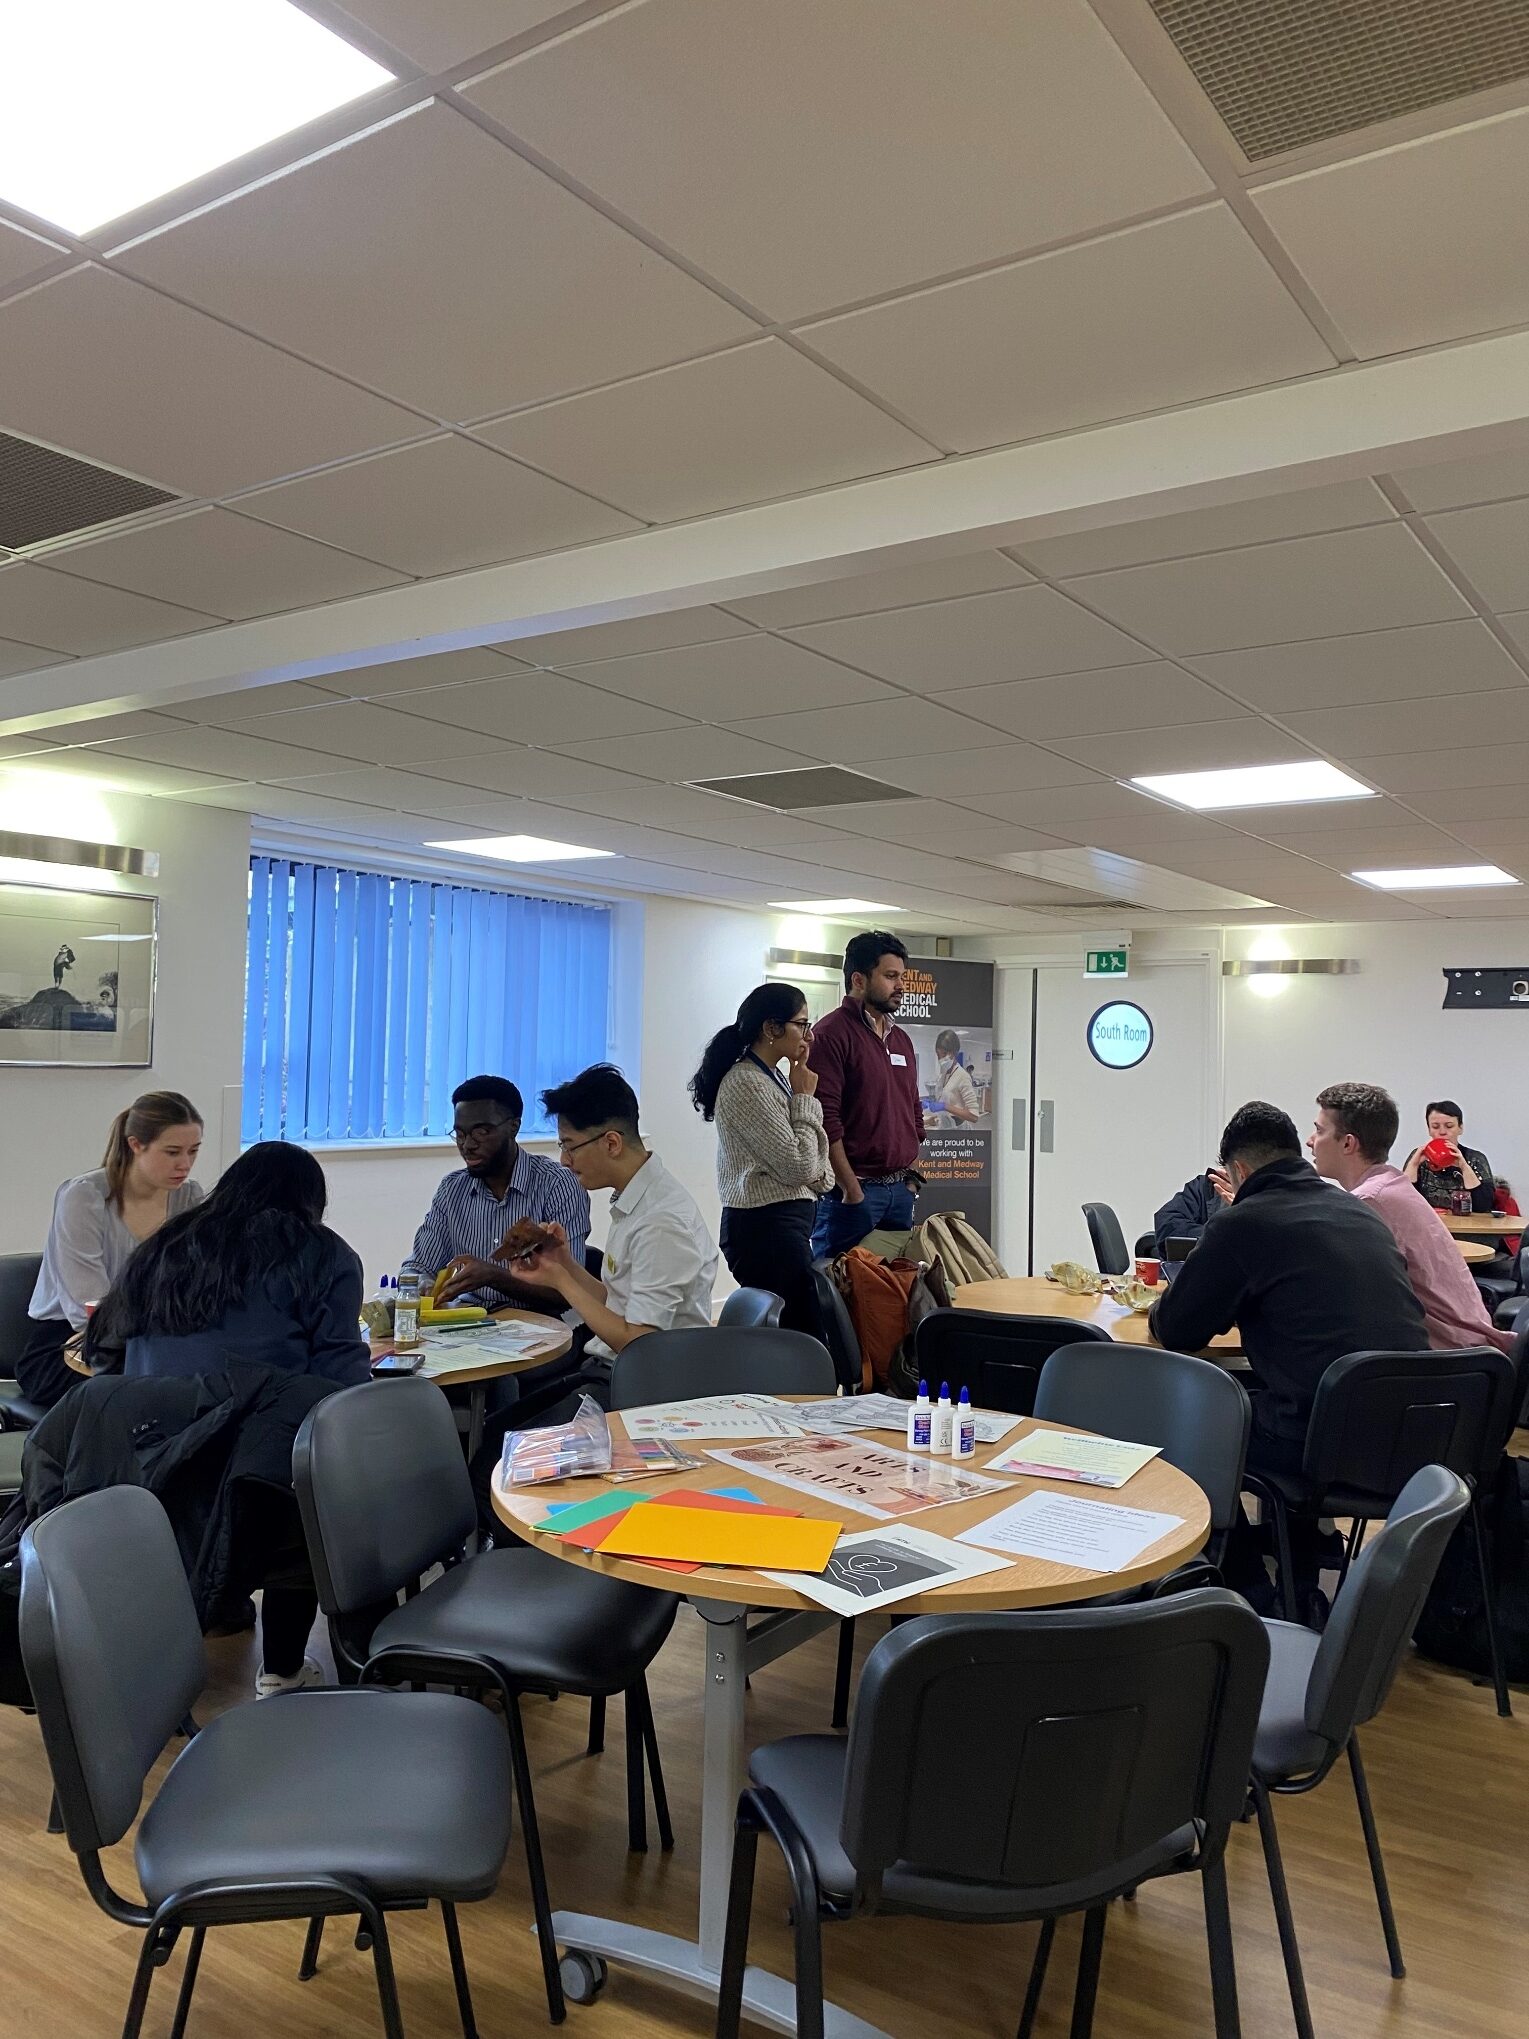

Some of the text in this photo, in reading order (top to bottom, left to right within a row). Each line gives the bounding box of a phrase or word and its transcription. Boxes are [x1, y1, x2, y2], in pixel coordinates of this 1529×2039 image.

[902, 969, 933, 982] ENT AND
[1096, 1021, 1147, 1041] South Room
[944, 1139, 966, 1148] proud
[966, 1139, 974, 1147] to
[975, 1138, 985, 1147] be
[930, 1149, 957, 1159] working
[918, 1160, 985, 1169] Kent and Medway
[923, 1171, 980, 1179] Medical School
[827, 1462, 882, 1477] AND
[774, 1462, 873, 1495] CRAFTS
